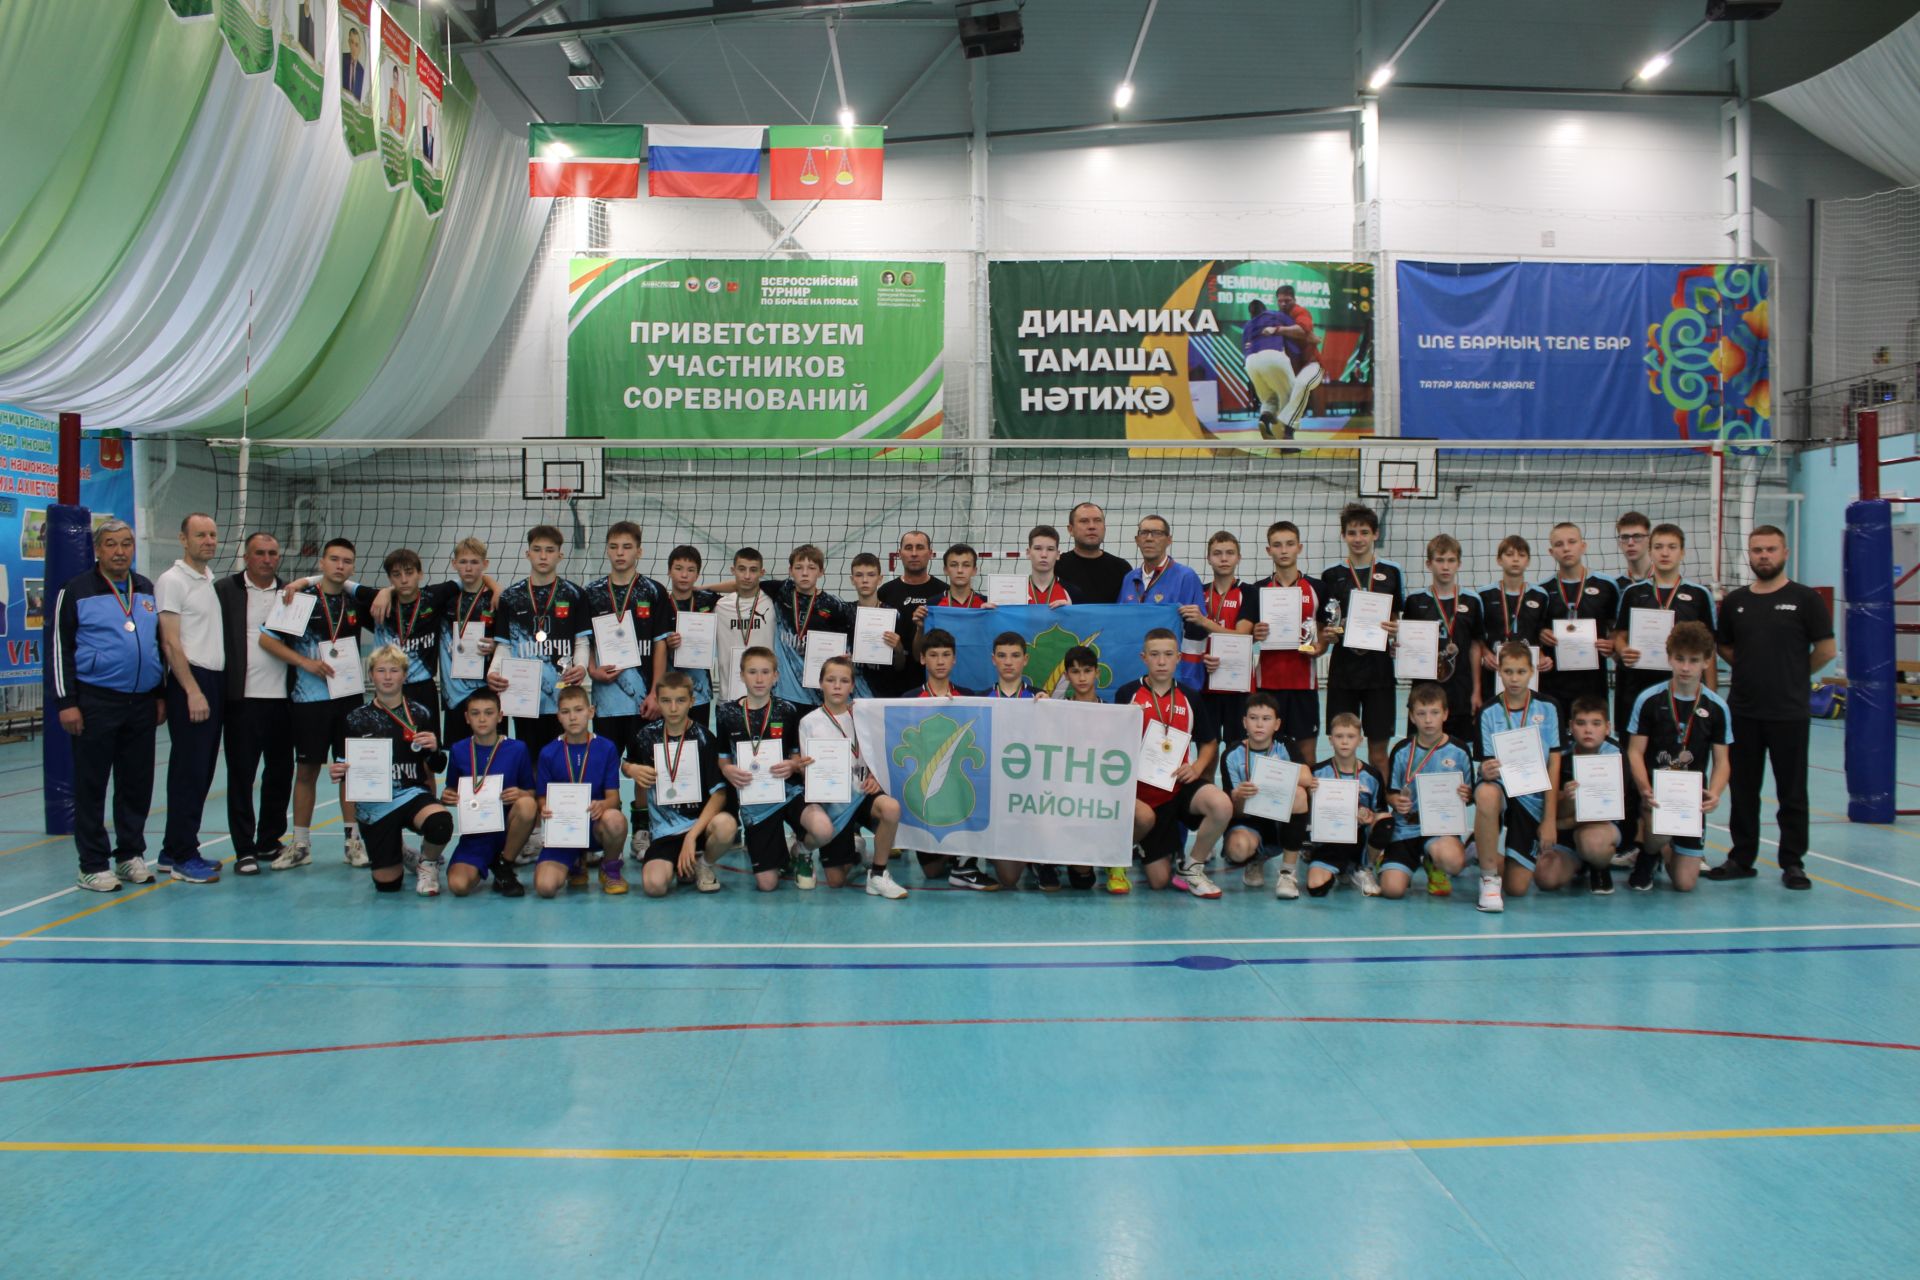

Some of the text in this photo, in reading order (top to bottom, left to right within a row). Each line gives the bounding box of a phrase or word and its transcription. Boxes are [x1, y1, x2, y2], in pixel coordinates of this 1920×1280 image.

[761, 275, 858, 286] ВСЕРОССИЙСКИЙ
[1297, 280, 1331, 296] МИРА
[761, 287, 811, 297] ТУРНИР
[823, 298, 859, 306] ПОЯСАХ
[1217, 291, 1233, 303] ПО
[630, 321, 864, 345] ПРИВЕТСТВУЕМ
[1018, 309, 1219, 338] ДИНАМИКА
[1459, 335, 1541, 353] БАРНЫҢ
[1544, 336, 1590, 350] ТЕЛЕ
[1595, 336, 1631, 351] БАР
[648, 355, 845, 378] УЧАСТНИКОВ
[1018, 348, 1172, 372] ТАМАША
[1419, 380, 1452, 389] ТАТАР
[1454, 380, 1491, 389] ХАЛЫК
[623, 383, 868, 411] СОРЕВНОВАНИЙ
[1020, 386, 1170, 413] НӘТИҖӘ
[17, 478, 58, 498] АХМЕТОВ
[730, 618, 761, 630] PUMA
[1001, 742, 1132, 787] ӘТНӘ
[1008, 790, 1121, 820] РАЙОНЫ
